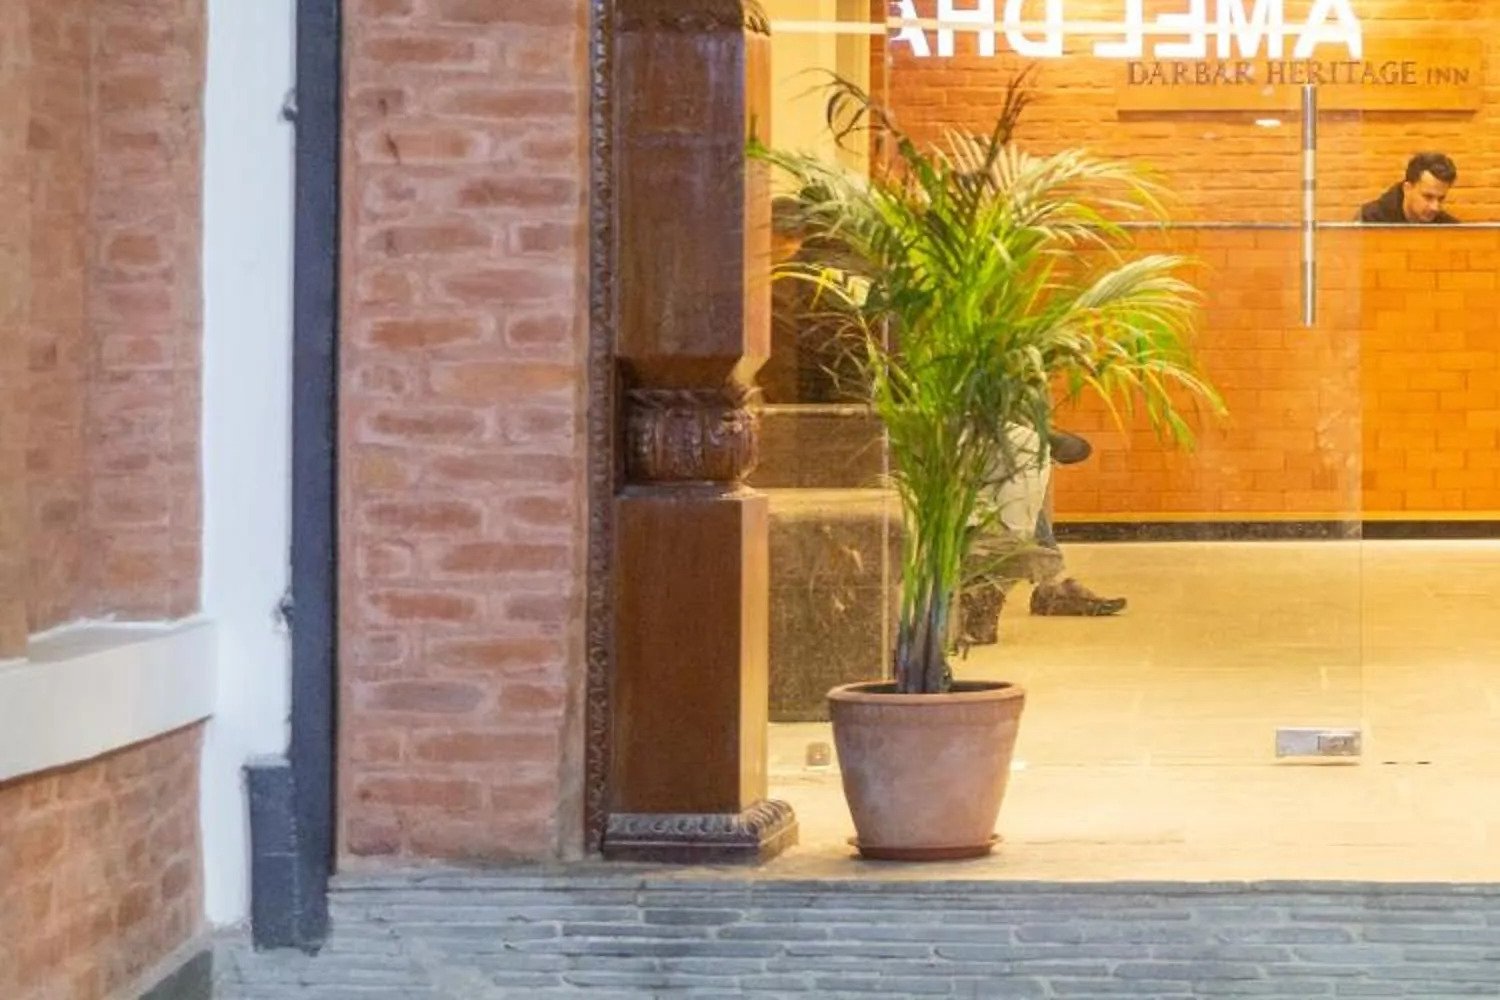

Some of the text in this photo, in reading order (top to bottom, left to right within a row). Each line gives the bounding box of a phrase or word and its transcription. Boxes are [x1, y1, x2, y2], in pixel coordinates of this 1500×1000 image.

[1127, 60, 1470, 86] DARBAR HERITAGE INN
